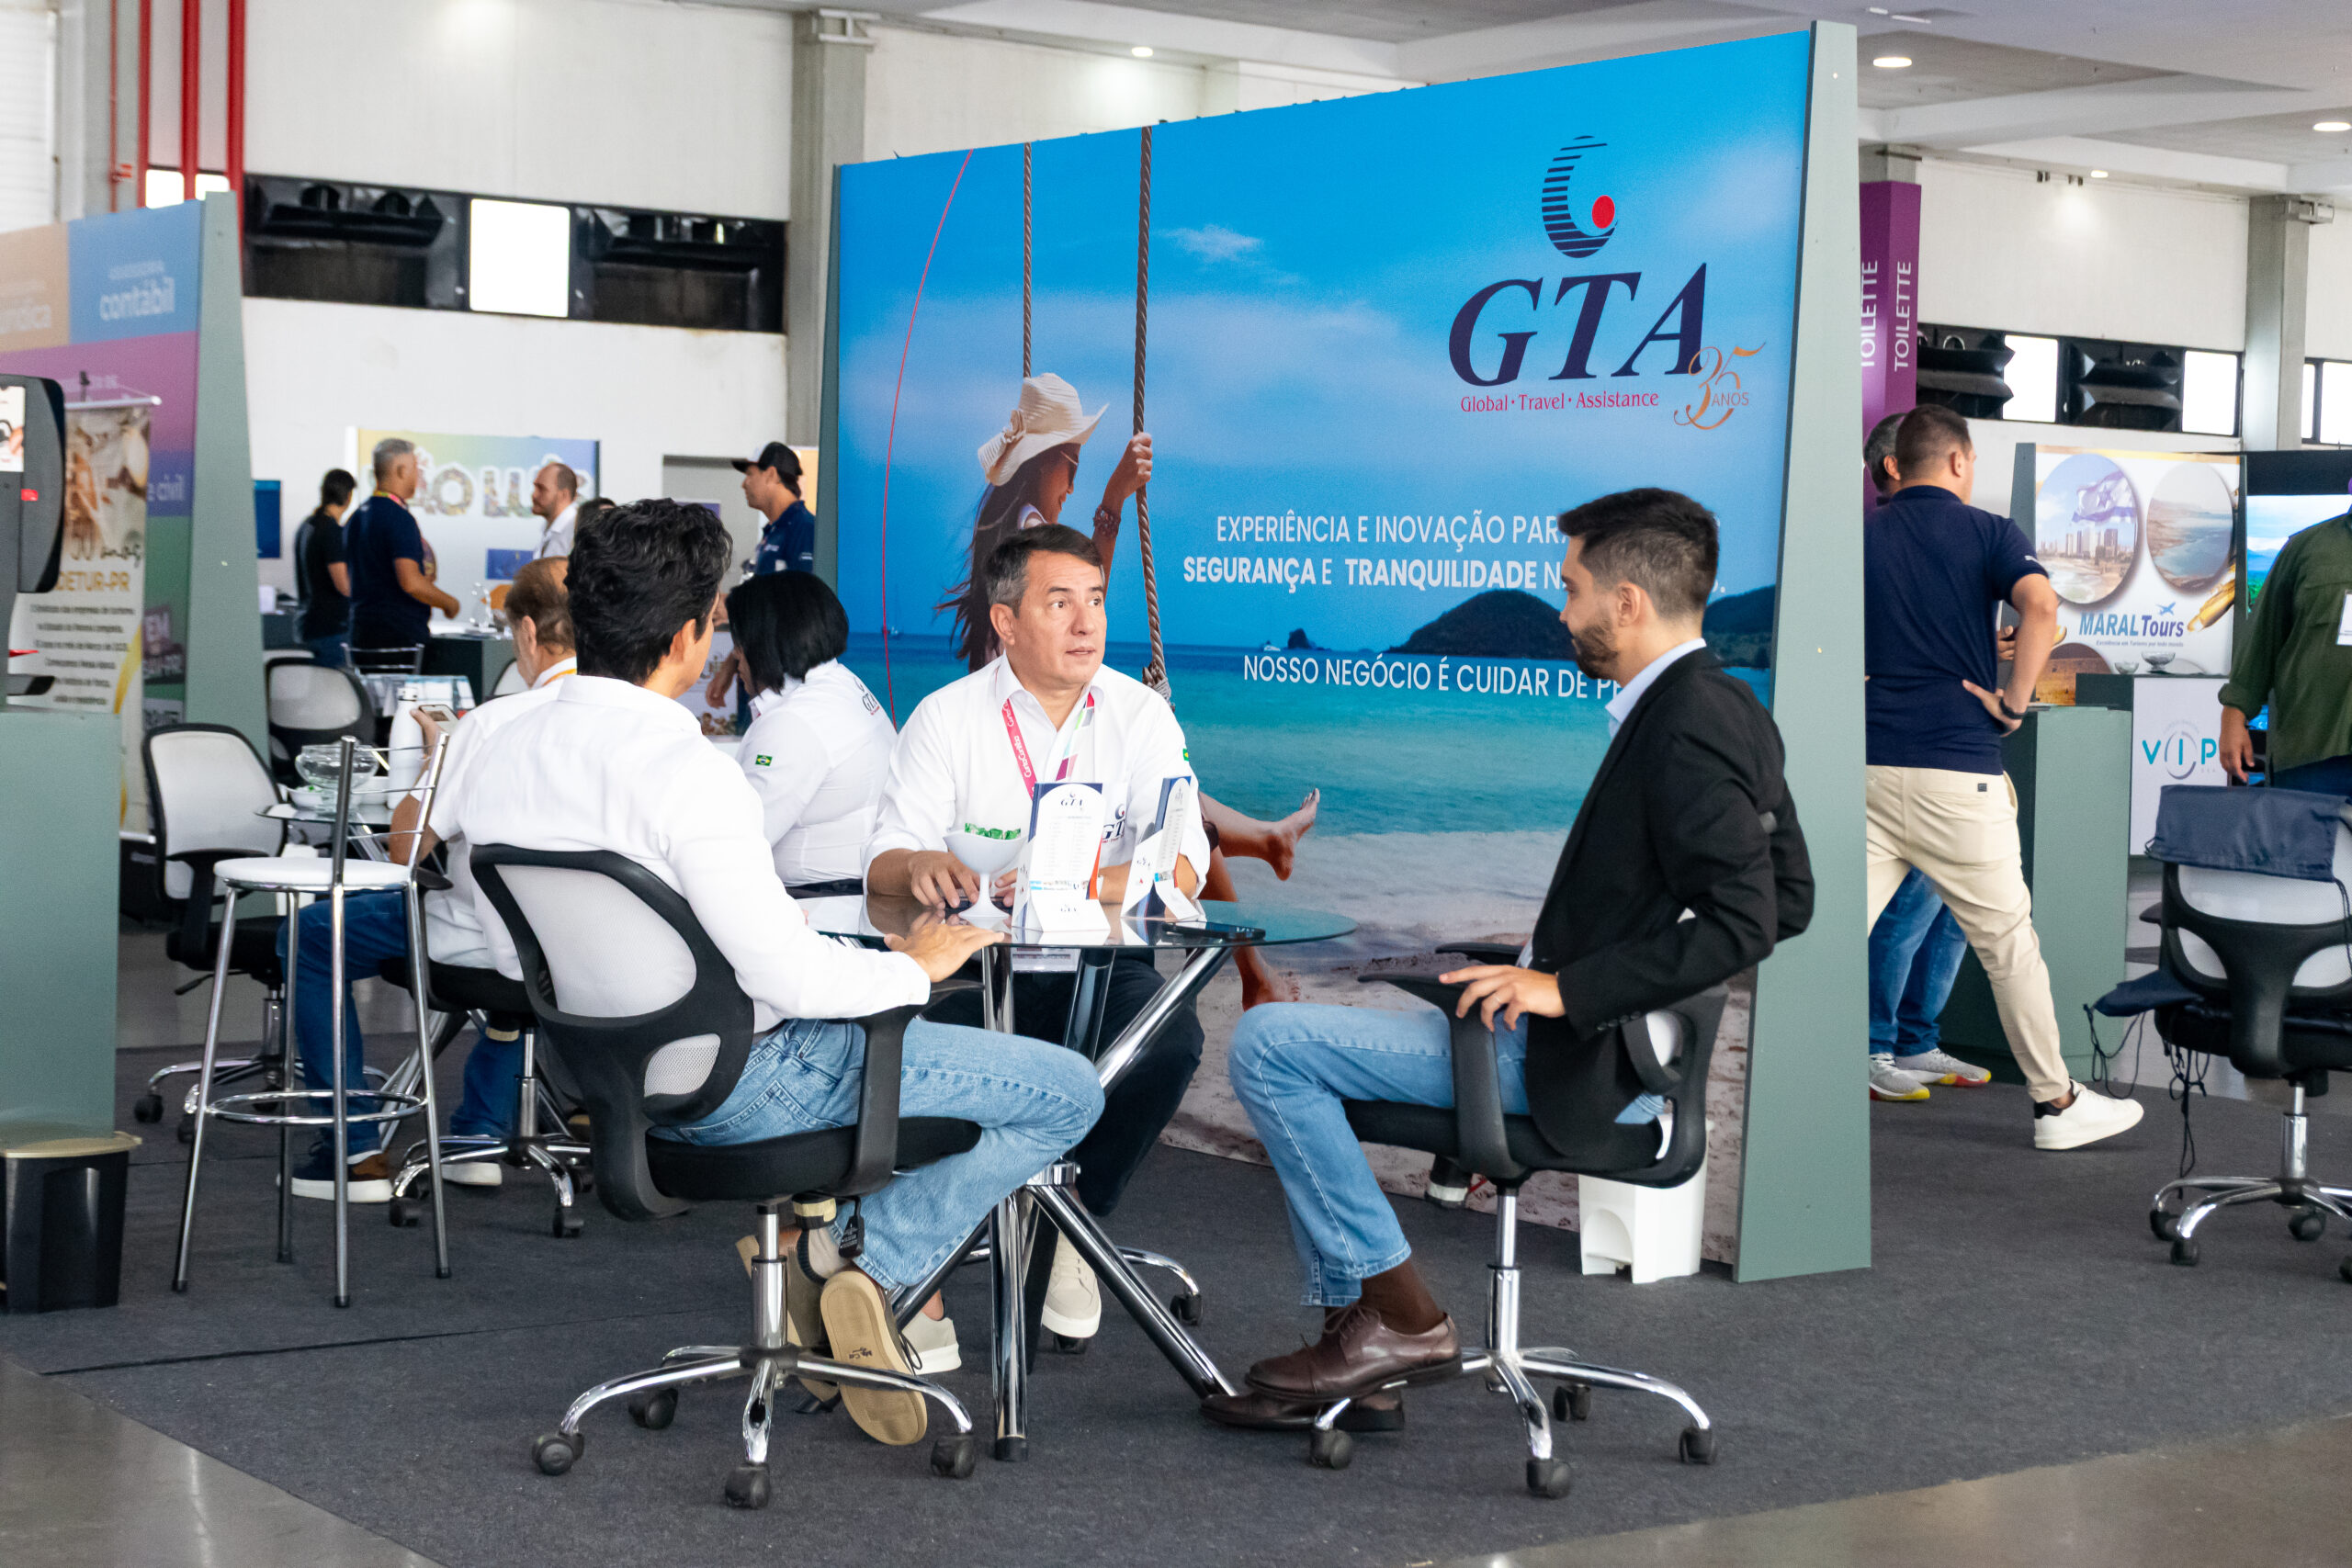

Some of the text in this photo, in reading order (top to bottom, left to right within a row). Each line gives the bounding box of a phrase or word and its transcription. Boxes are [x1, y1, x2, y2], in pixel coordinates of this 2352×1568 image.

[1449, 263, 1707, 387] GTA
[1894, 261, 1911, 372] TOILETTE
[1461, 390, 1659, 412] Global Travel Assistance
[1674, 342, 1767, 430] 35
[1711, 392, 1749, 407] ANOS
[1217, 509, 1569, 553] EXPERIÊNCIA E INOVAÇÃO PAR
[1183, 556, 1317, 594] SEGURANÇA
[1321, 558, 1332, 585] E
[1345, 558, 1537, 591] TRANQUILIDADE
[2078, 610, 2184, 637] MARAL Tours
[1243, 654, 1319, 684] NOSSO
[1326, 653, 1431, 690] NEGÓCIO
[1438, 655, 1450, 692] É
[1456, 664, 1550, 697] CUIDAR
[1557, 669, 1589, 699] DE
[2142, 738, 2217, 766] VIP
